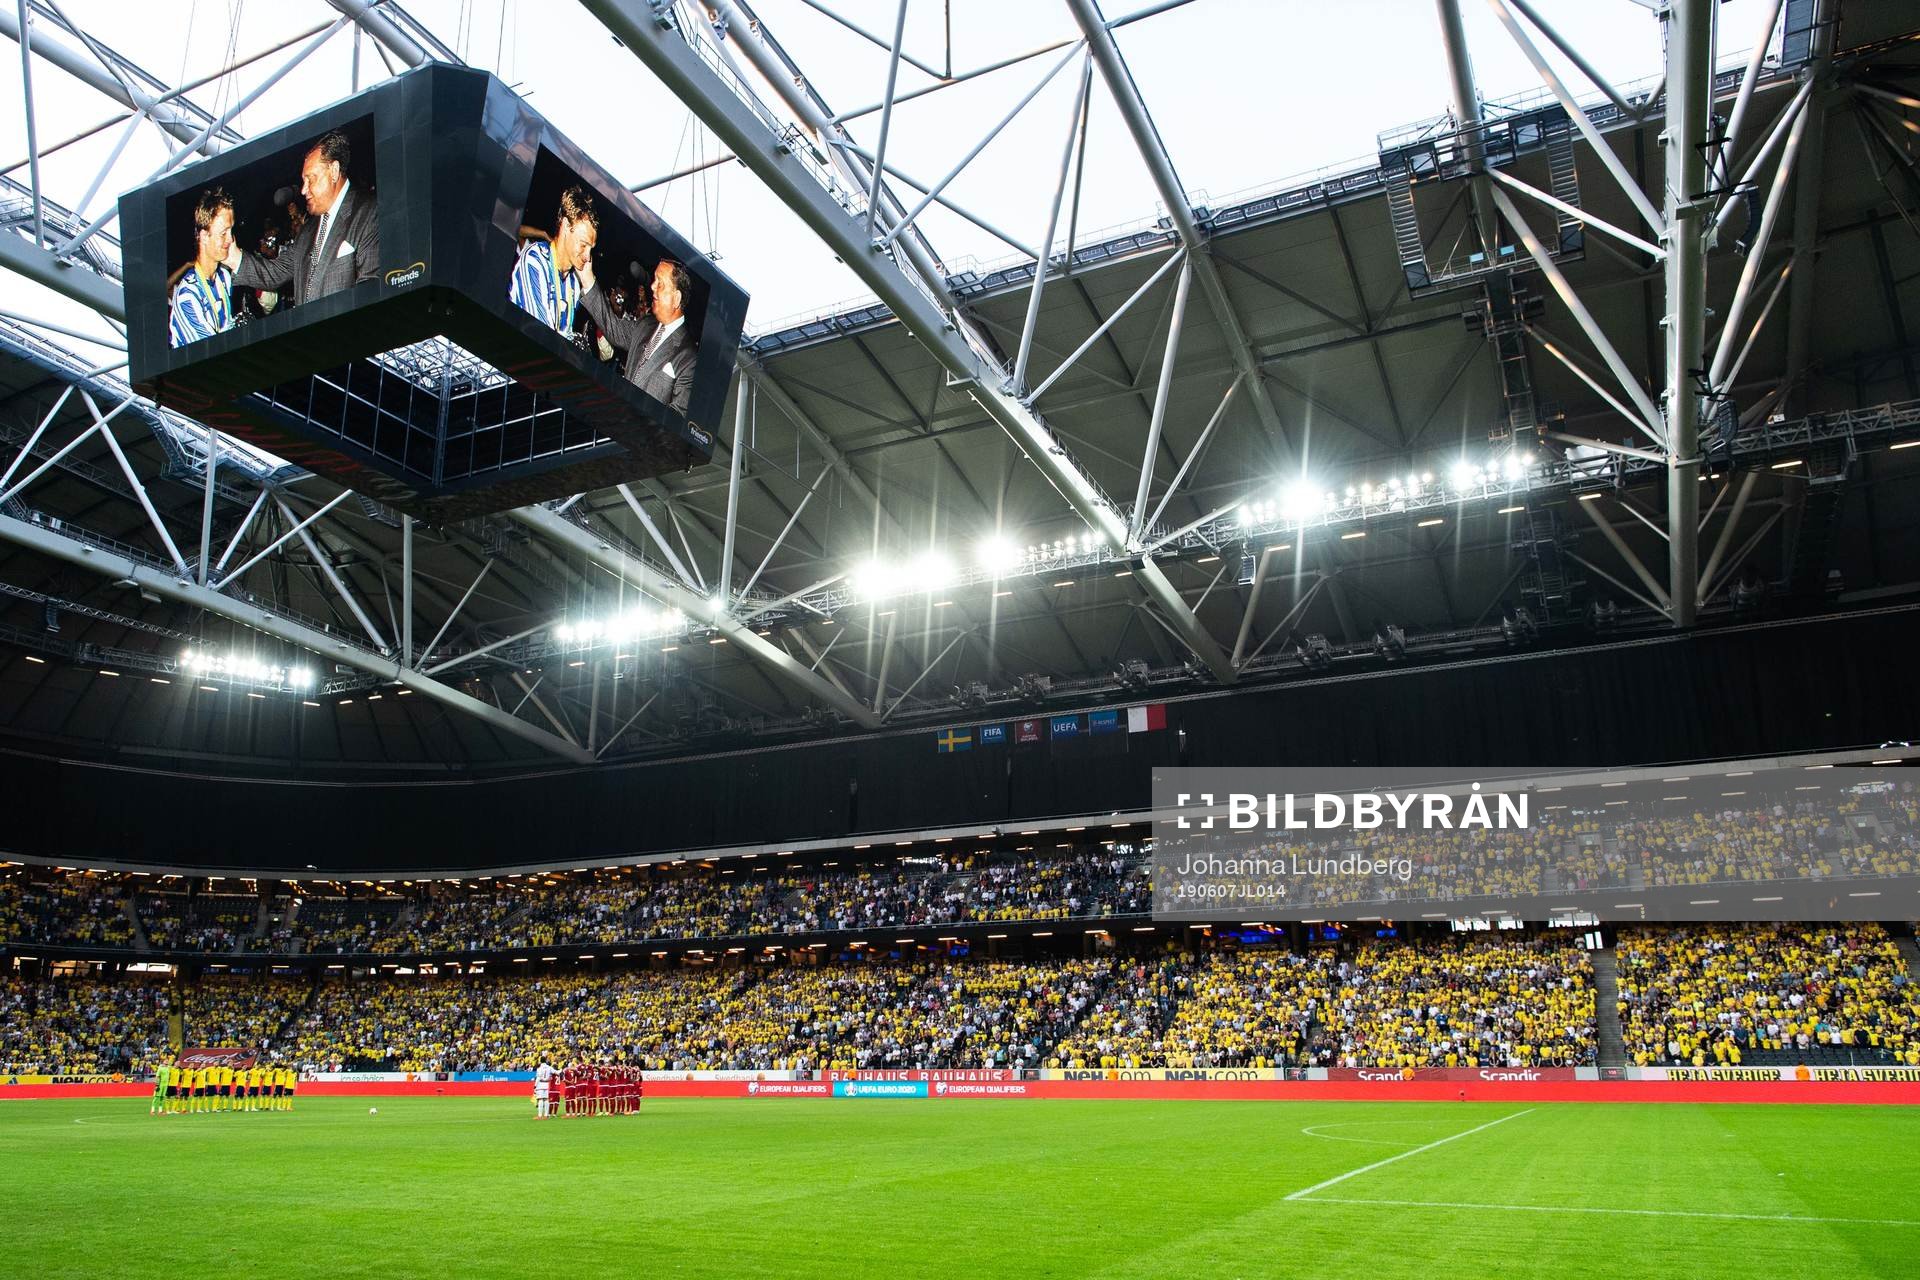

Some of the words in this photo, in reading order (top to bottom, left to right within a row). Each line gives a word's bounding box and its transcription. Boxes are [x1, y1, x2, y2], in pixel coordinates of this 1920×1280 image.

[391, 270, 420, 286] friends
[984, 727, 1002, 737] FIFA
[1053, 722, 1077, 732] UEFA
[920, 1071, 1003, 1080] BAUHAUS
[1479, 1070, 1541, 1080] Scandic
[1666, 1069, 1709, 1081] HEJA
[1710, 1069, 1781, 1081] SVERIGE
[1813, 1069, 1860, 1081] HEJA
[760, 1085, 791, 1093] EUROPEAN
[792, 1085, 827, 1093] QUALIFIERS
[858, 1085, 877, 1093] UEFA
[877, 1085, 897, 1093] EURO
[897, 1085, 916, 1093] 2020
[949, 1085, 986, 1093] EUROPEAN
[986, 1085, 1026, 1093] QUALIFIERS
